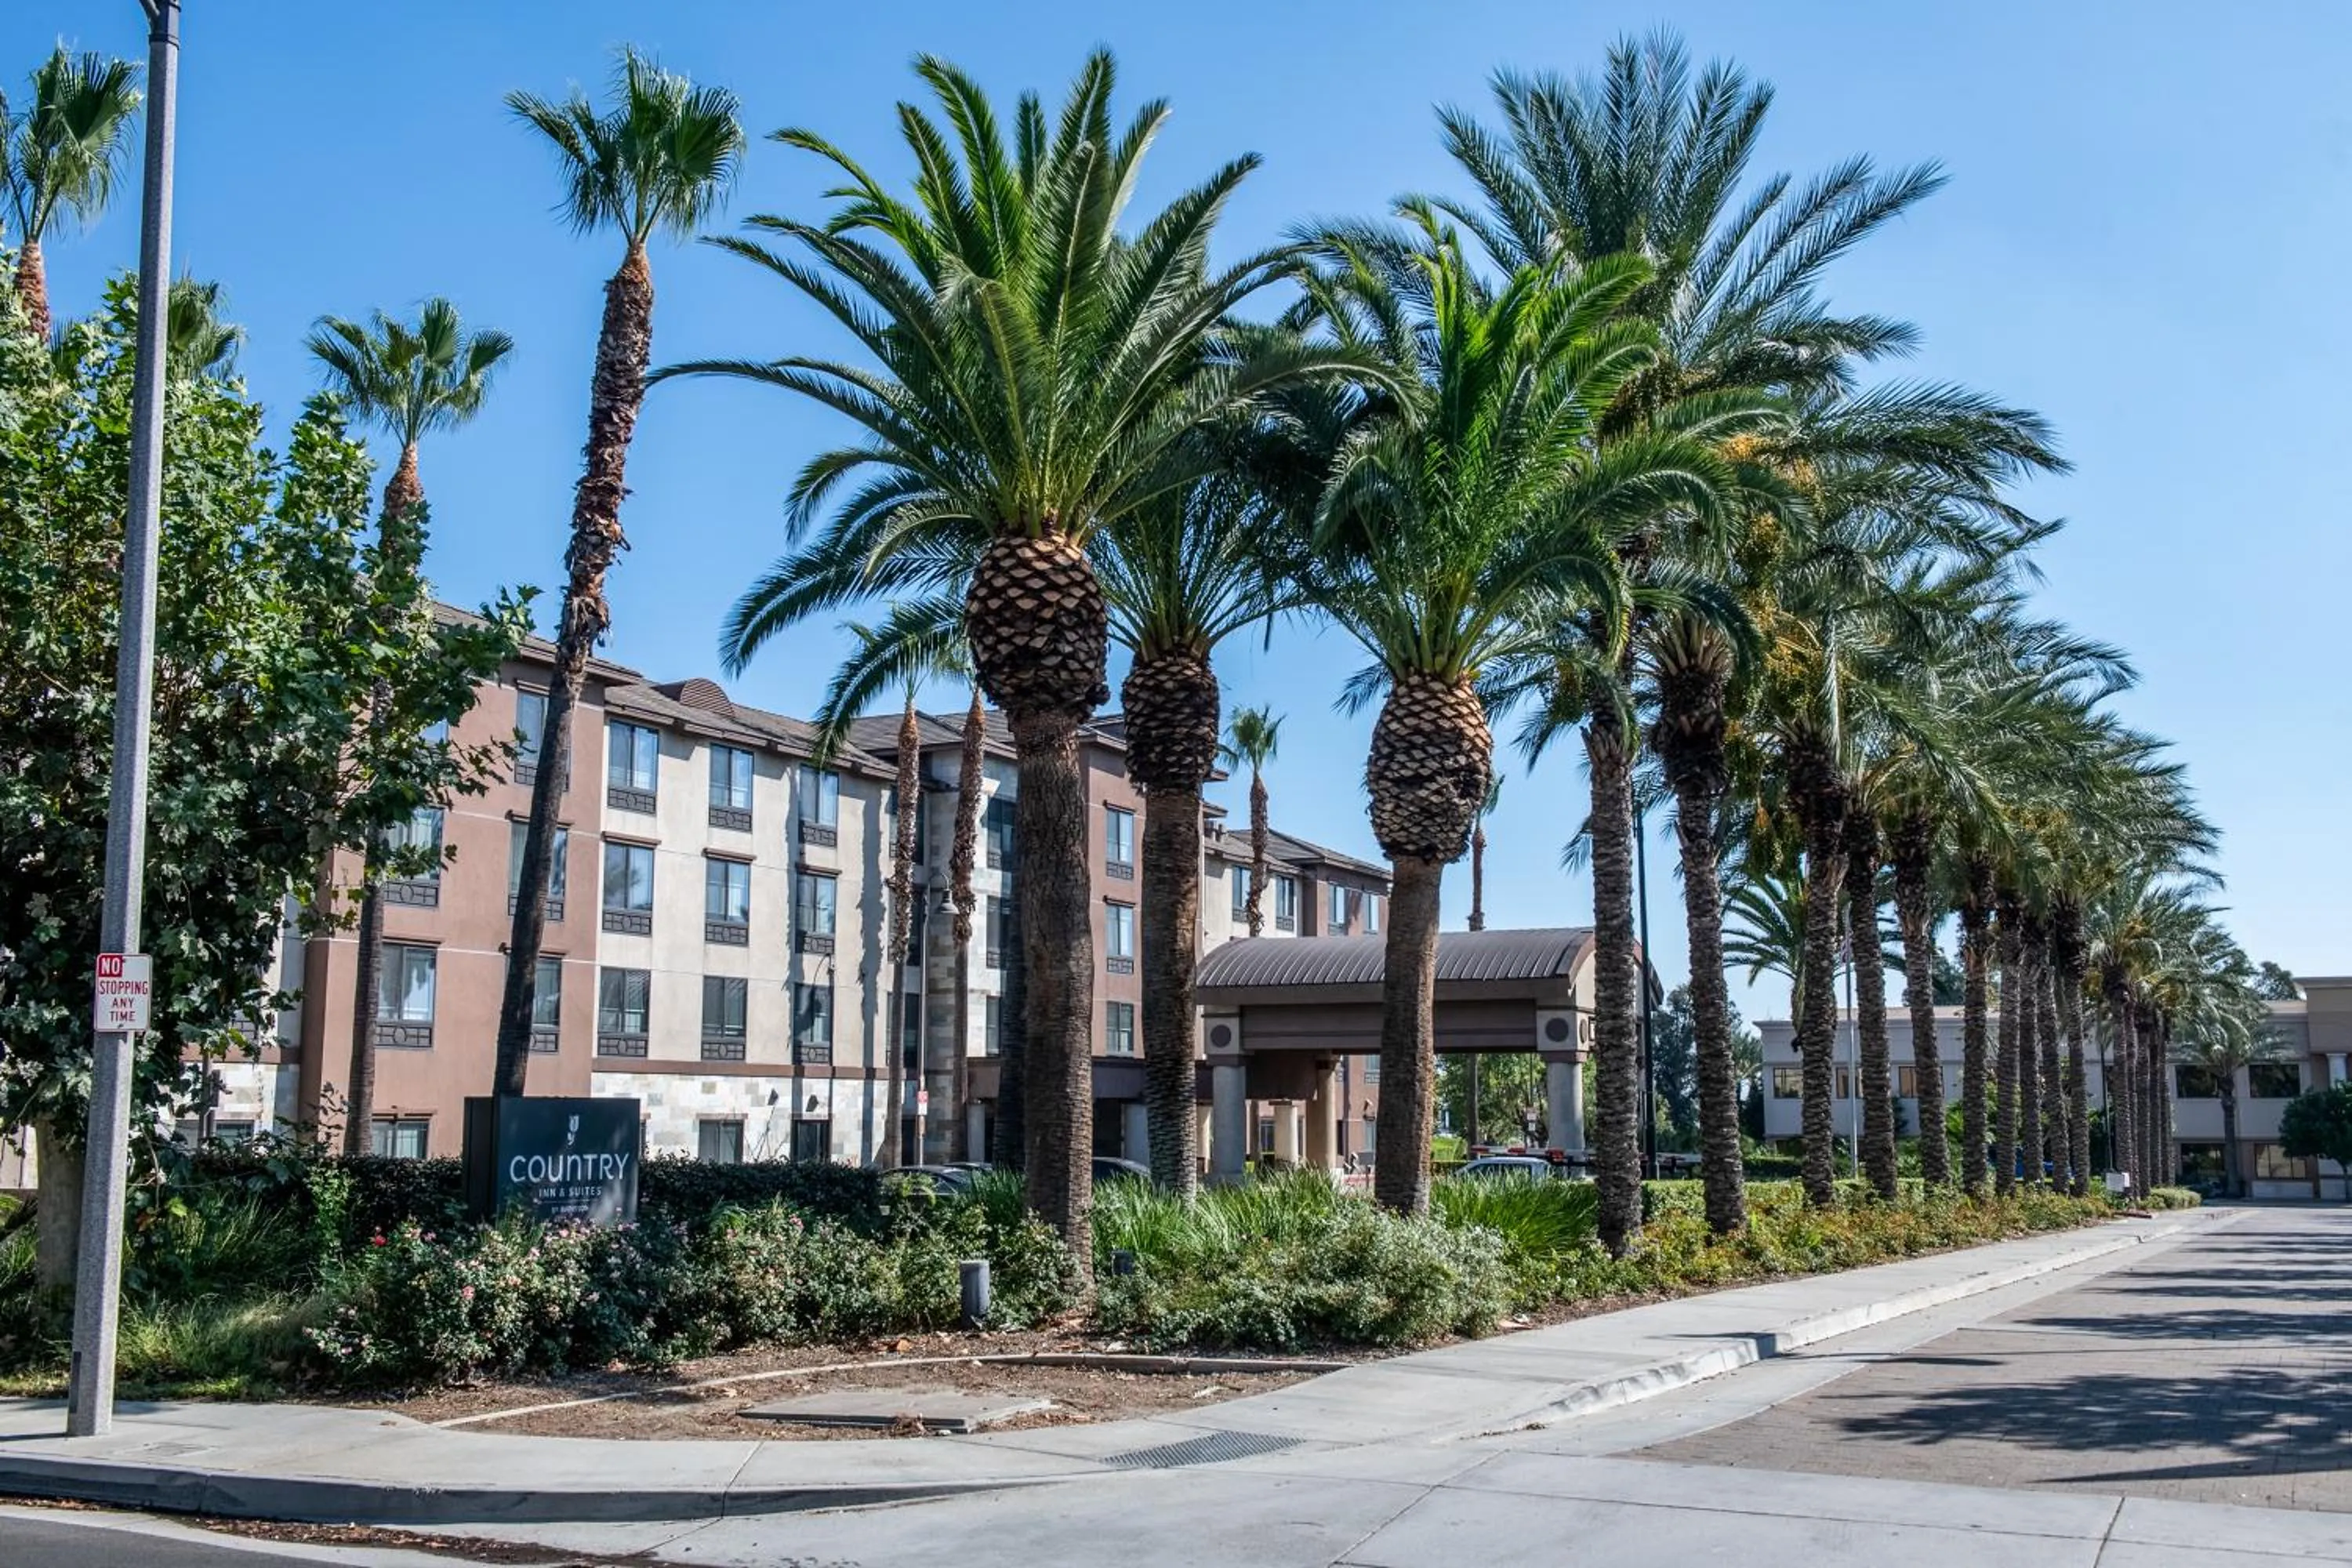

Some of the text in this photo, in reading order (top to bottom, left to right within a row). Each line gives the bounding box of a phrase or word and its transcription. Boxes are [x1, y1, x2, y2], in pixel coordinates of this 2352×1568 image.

[100, 957, 121, 975] NO
[100, 981, 148, 995] STOPPING
[112, 997, 134, 1007] ANY
[110, 1011, 135, 1022] TIME
[568, 1186, 602, 1197] SUITES
